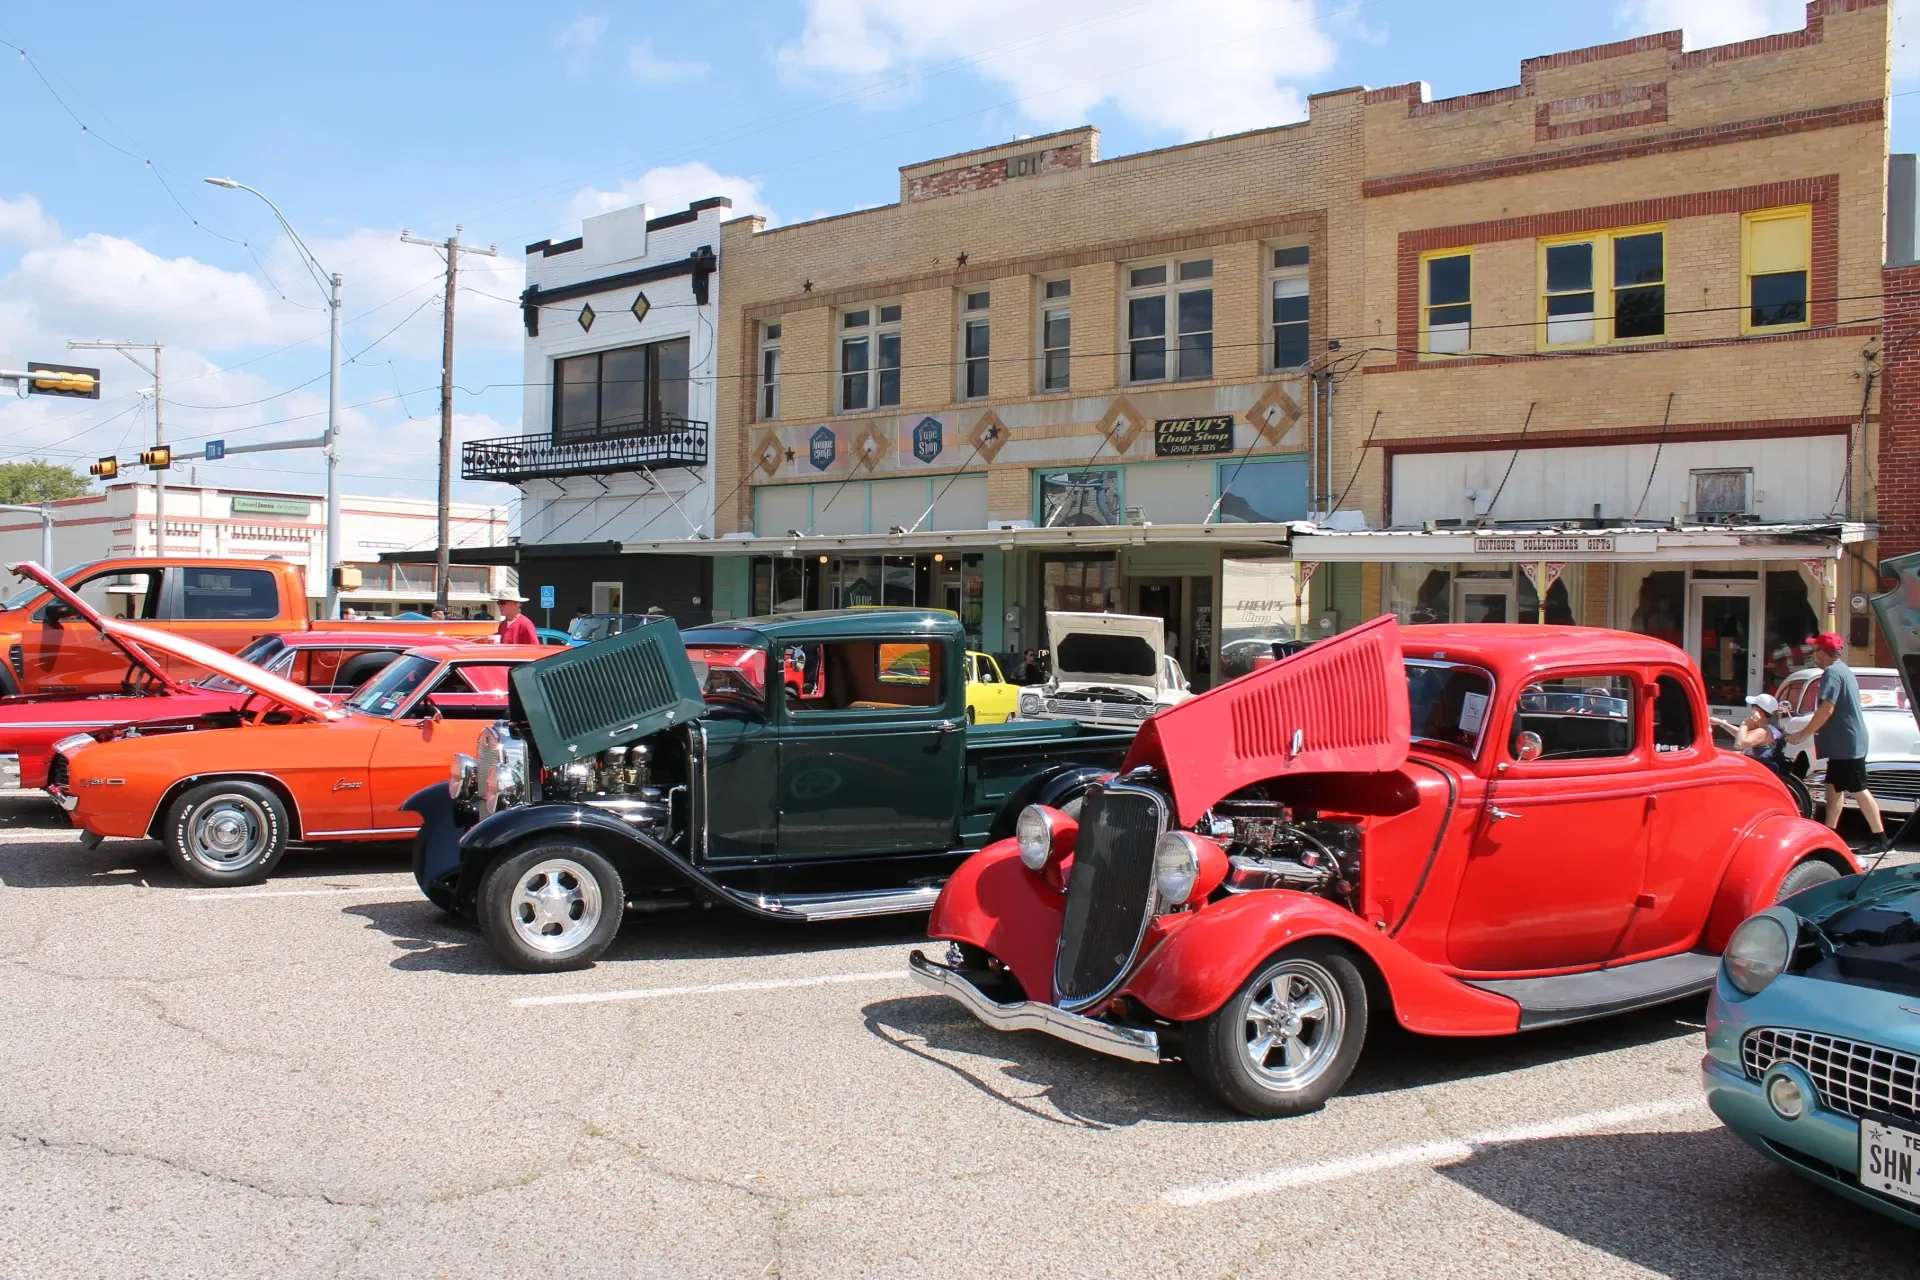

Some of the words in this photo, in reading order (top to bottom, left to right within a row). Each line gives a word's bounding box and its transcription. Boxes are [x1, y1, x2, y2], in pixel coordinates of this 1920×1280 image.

[1158, 417, 1229, 433] CHEVI'S
[918, 428, 937, 441] Vape
[1158, 433, 1192, 444] Chop
[1194, 431, 1229, 442] Shop
[918, 441, 938, 455] Shop
[1478, 539, 1516, 551] ANTIQUES
[1523, 538, 1579, 550] COLLECTIBLES
[1237, 600, 1286, 612] CHEVI'S
[181, 804, 193, 820] T/A
[177, 824, 192, 861] Radial
[1870, 1144, 1912, 1185] SHN
[1896, 1187, 1908, 1195] The
